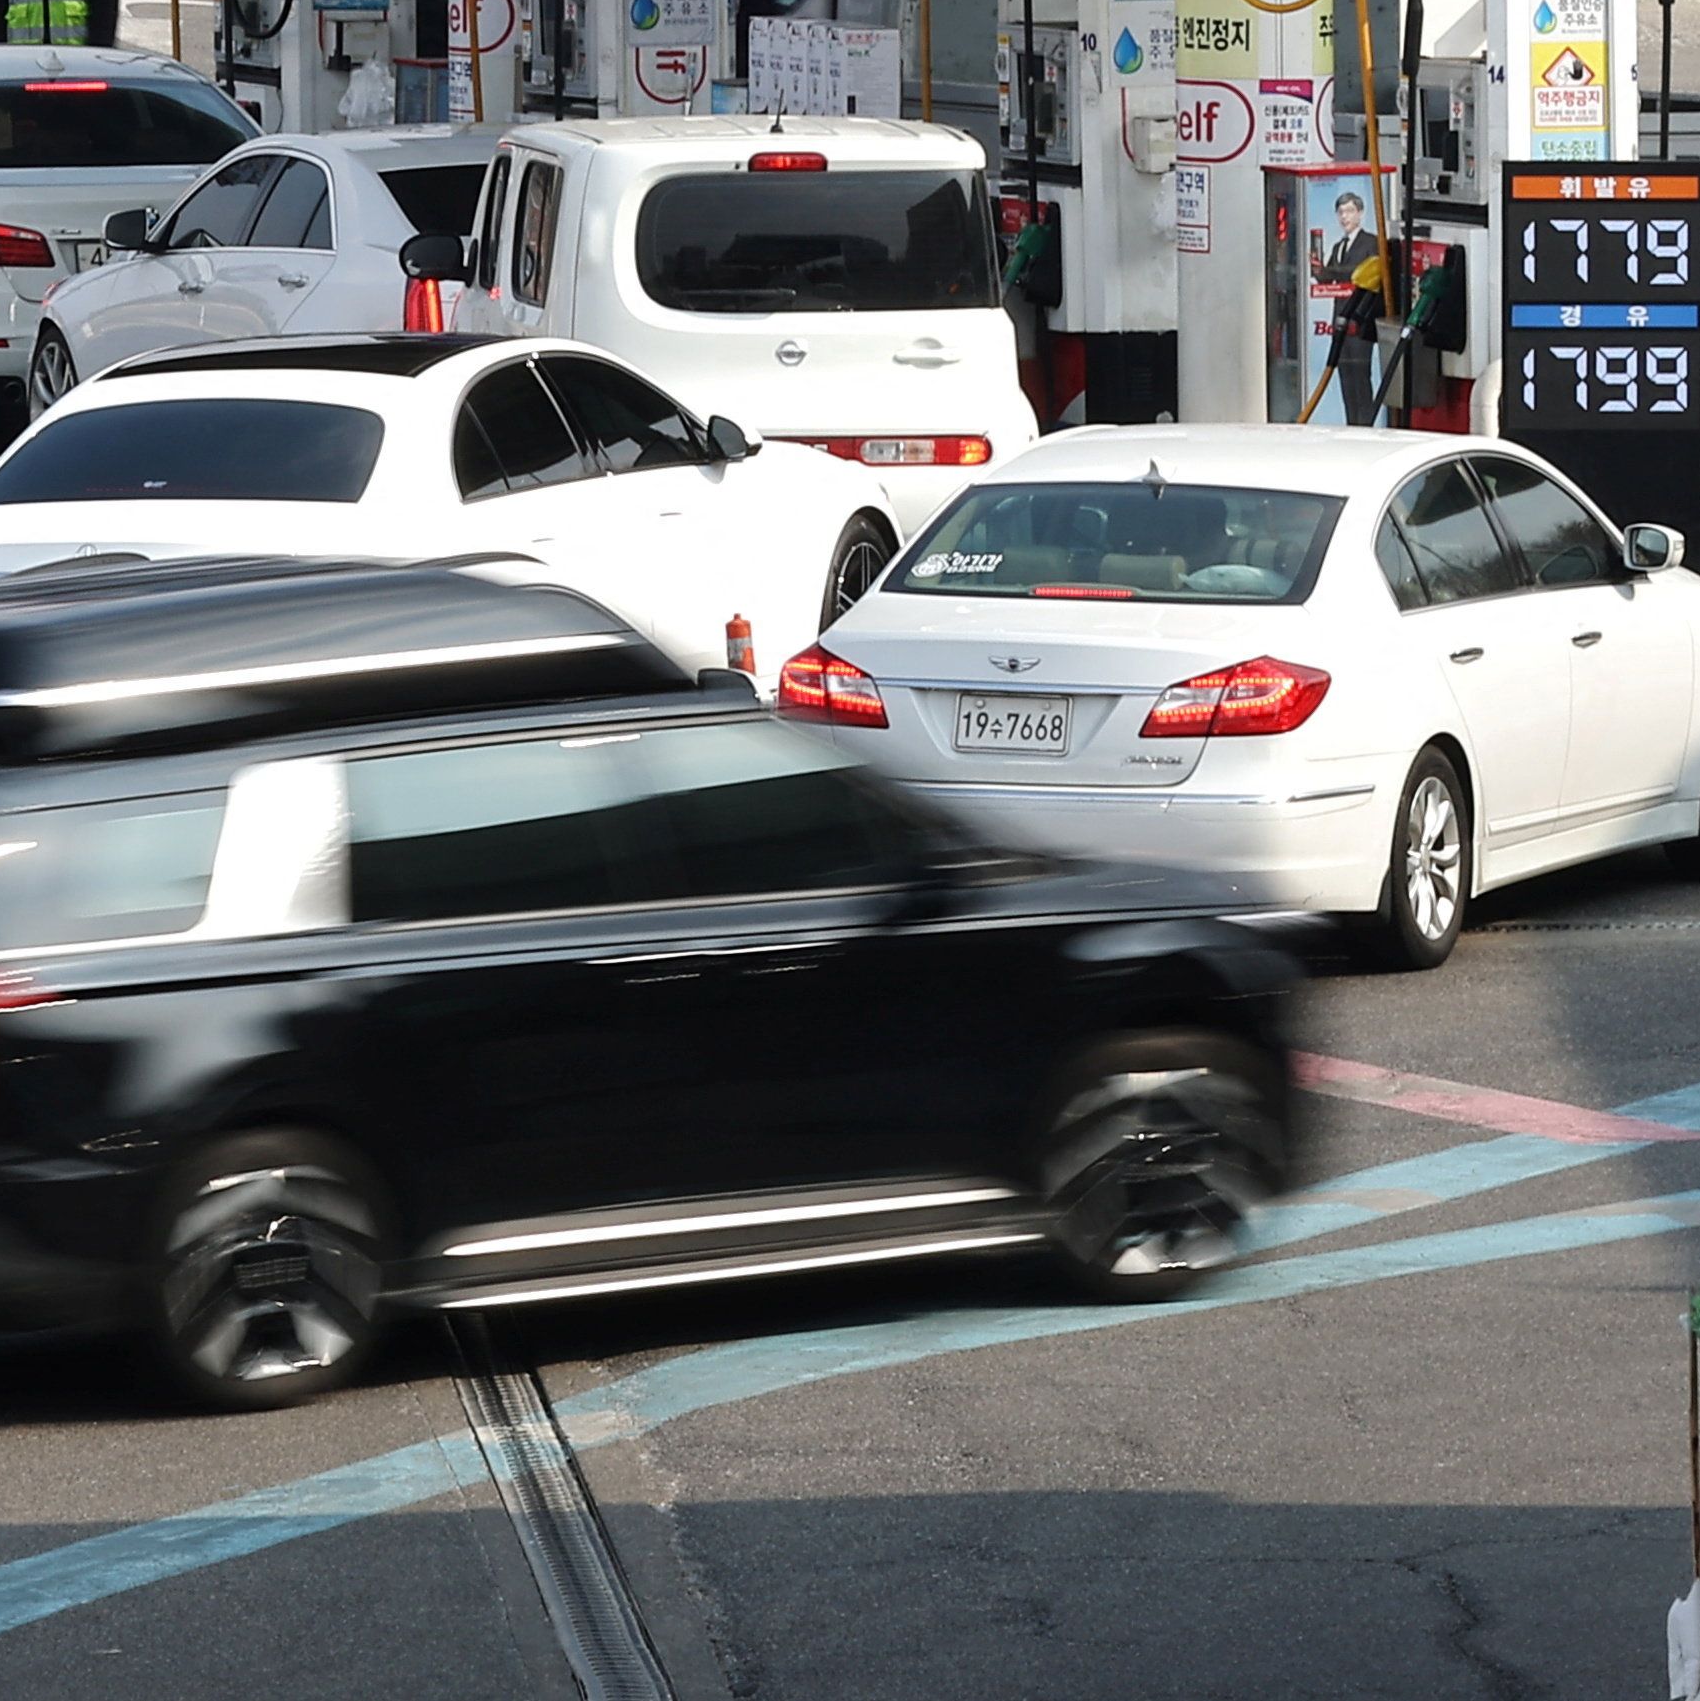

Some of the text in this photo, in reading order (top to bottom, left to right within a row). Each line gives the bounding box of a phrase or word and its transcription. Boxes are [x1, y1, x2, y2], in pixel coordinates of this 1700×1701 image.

[1564, 12, 1598, 26] 주유소
[1080, 33, 1097, 50] 10
[1488, 65, 1505, 84] 14
[1537, 90, 1600, 107] 역주행금지
[1523, 219, 1689, 285] 1779
[1523, 347, 1688, 412] 1799
